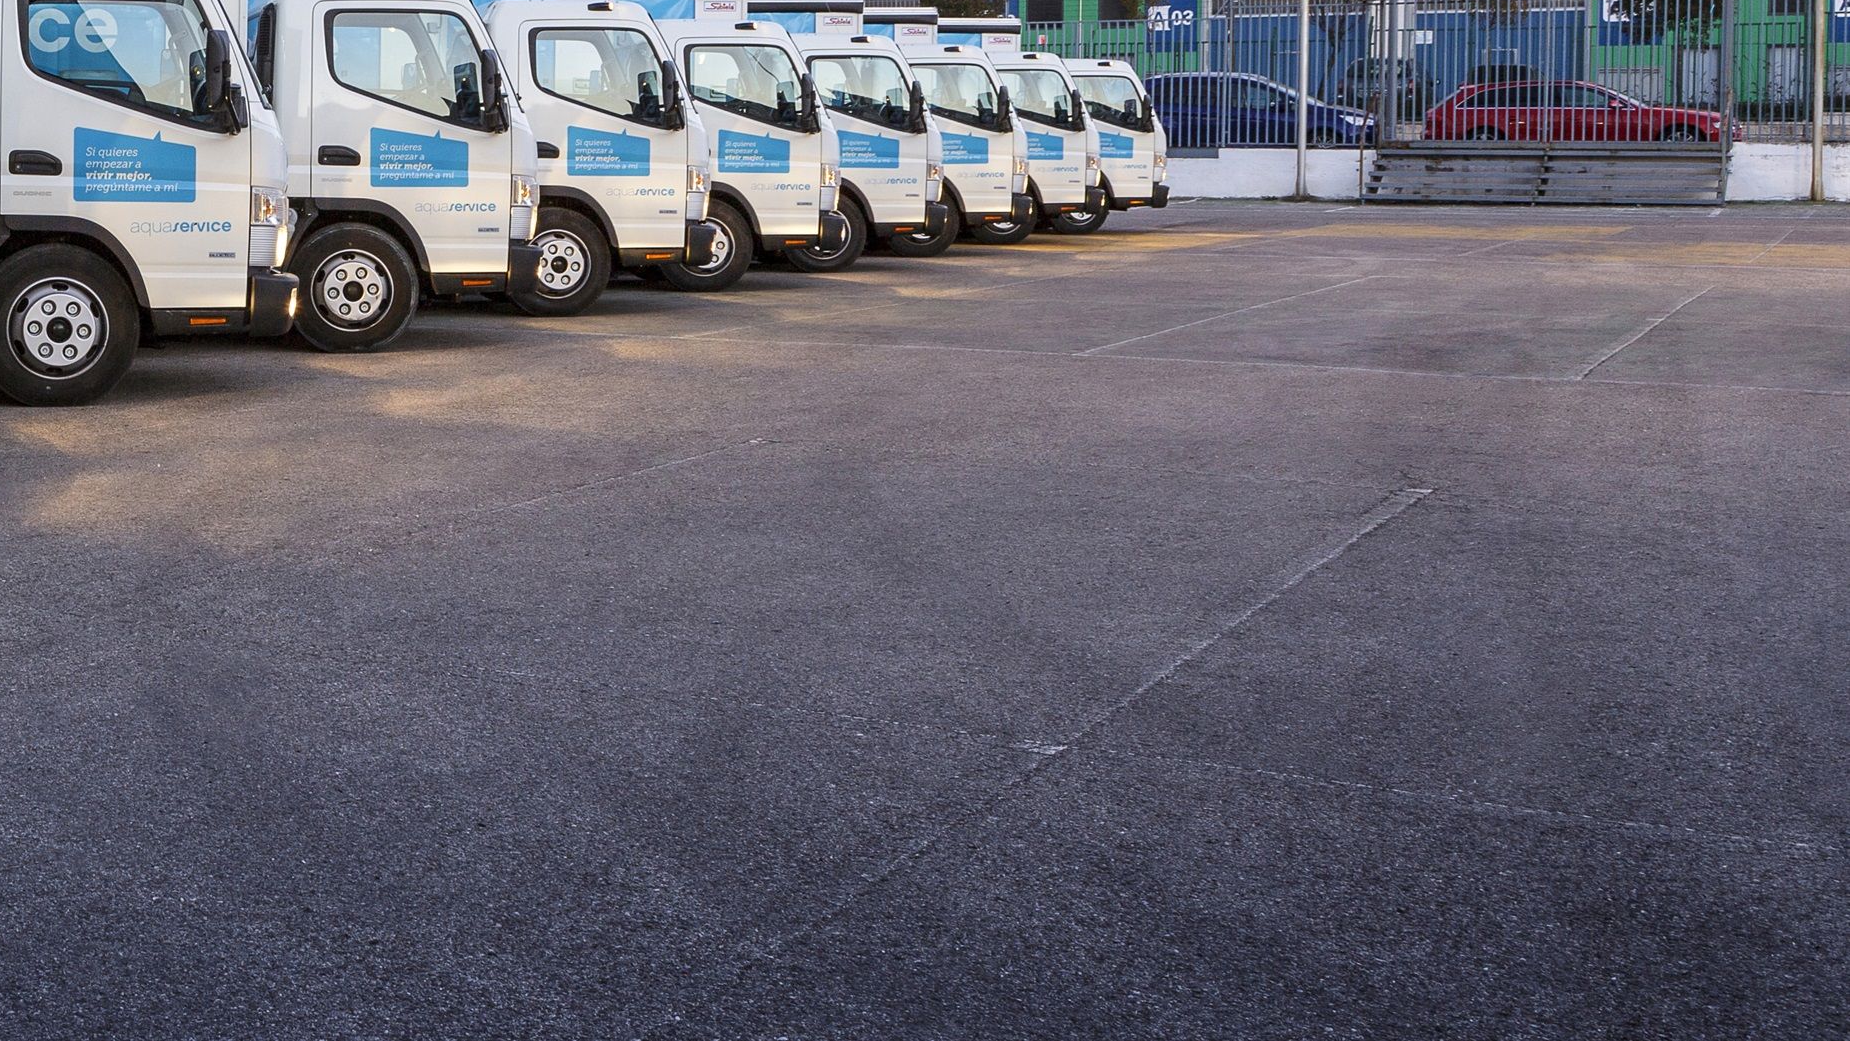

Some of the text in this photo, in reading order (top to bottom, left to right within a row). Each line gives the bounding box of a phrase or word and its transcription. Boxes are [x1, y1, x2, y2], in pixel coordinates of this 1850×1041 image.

[1171, 10, 1194, 26] 03
[85, 146, 138, 159] Si quieres
[379, 142, 422, 152] Si quieres
[379, 153, 419, 162] empezar
[85, 160, 142, 170] empezar a
[379, 162, 403, 170] vivir
[85, 170, 153, 182] vivir mejor,
[85, 182, 152, 194] pregúntame
[415, 202, 496, 215] aquaservice
[130, 221, 232, 237] aquaservice
